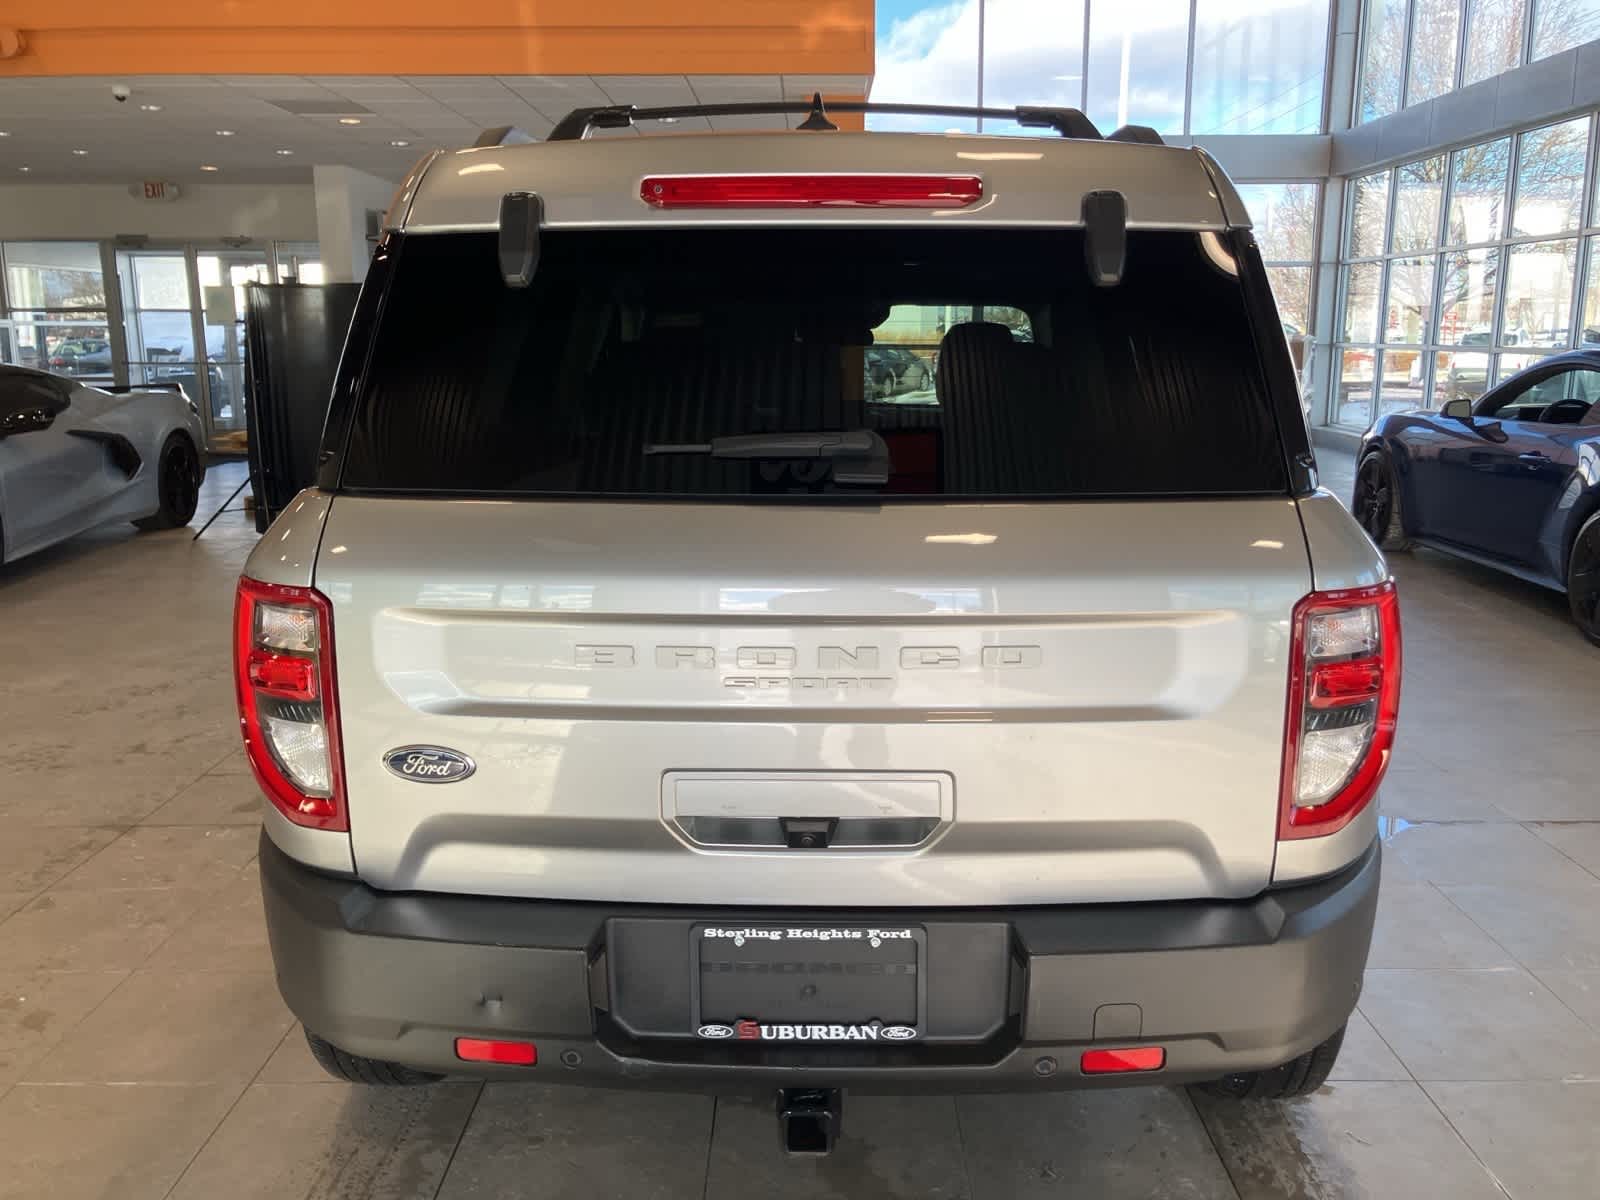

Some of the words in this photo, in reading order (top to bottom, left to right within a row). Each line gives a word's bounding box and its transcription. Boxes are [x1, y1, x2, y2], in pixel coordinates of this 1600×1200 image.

[144, 182, 167, 199] EXIT
[574, 643, 1041, 670] BRONCO
[723, 676, 893, 689] SPORT
[402, 753, 451, 776] Ford
[704, 928, 782, 940] Sterling
[786, 929, 862, 940] Heights
[867, 930, 912, 939] Ford
[738, 1022, 878, 1040] SUBURBAN
